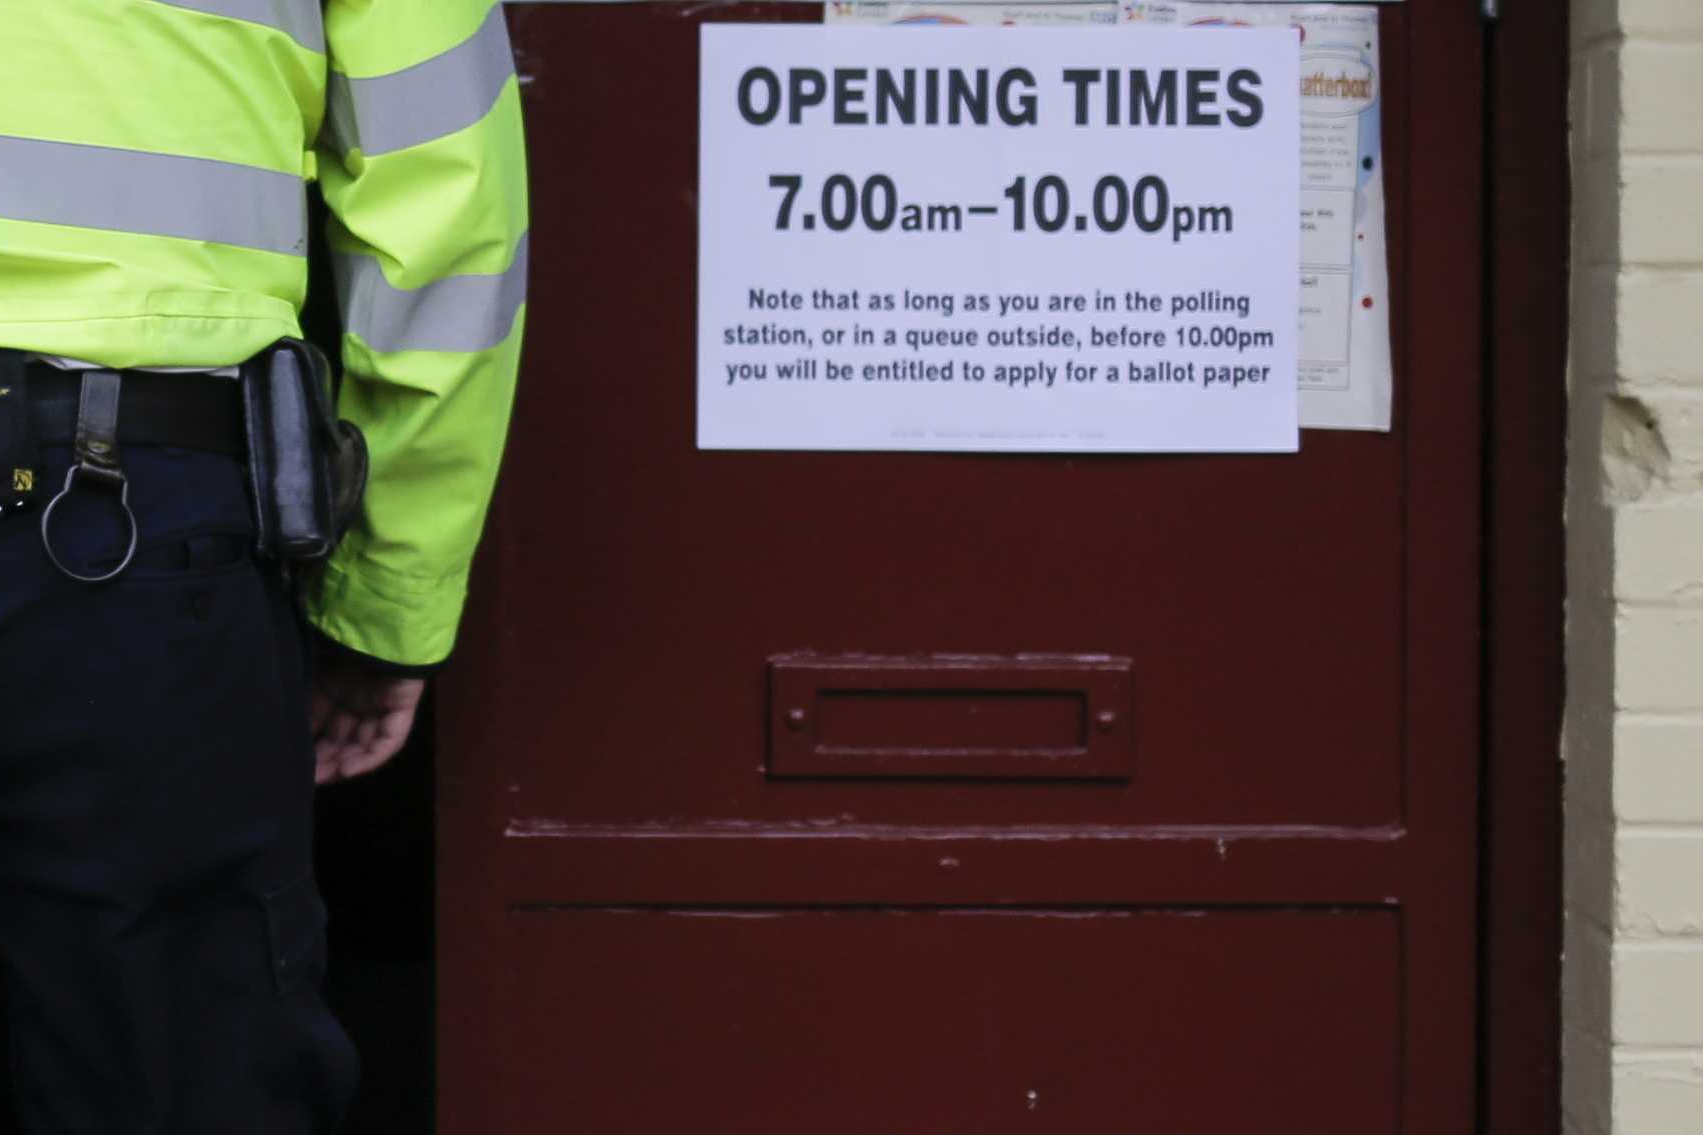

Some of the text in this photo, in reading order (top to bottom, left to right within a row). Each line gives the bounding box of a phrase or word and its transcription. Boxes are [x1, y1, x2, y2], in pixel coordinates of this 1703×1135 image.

[737, 66, 1264, 128] OPENING TIMES
[748, 288, 1250, 318] Note that as long as you are in the polling
[723, 323, 1274, 352] station, or in a queue outside, before 10.00pm
[725, 363, 767, 386] you
[776, 359, 817, 380] will
[825, 359, 854, 381] be
[862, 359, 954, 382] entitled
[962, 361, 985, 382] to
[993, 360, 1057, 388] apply
[1065, 360, 1098, 383] for
[1106, 366, 1120, 383] a
[1128, 361, 1195, 383] ballot
[1203, 366, 1271, 388] paper
